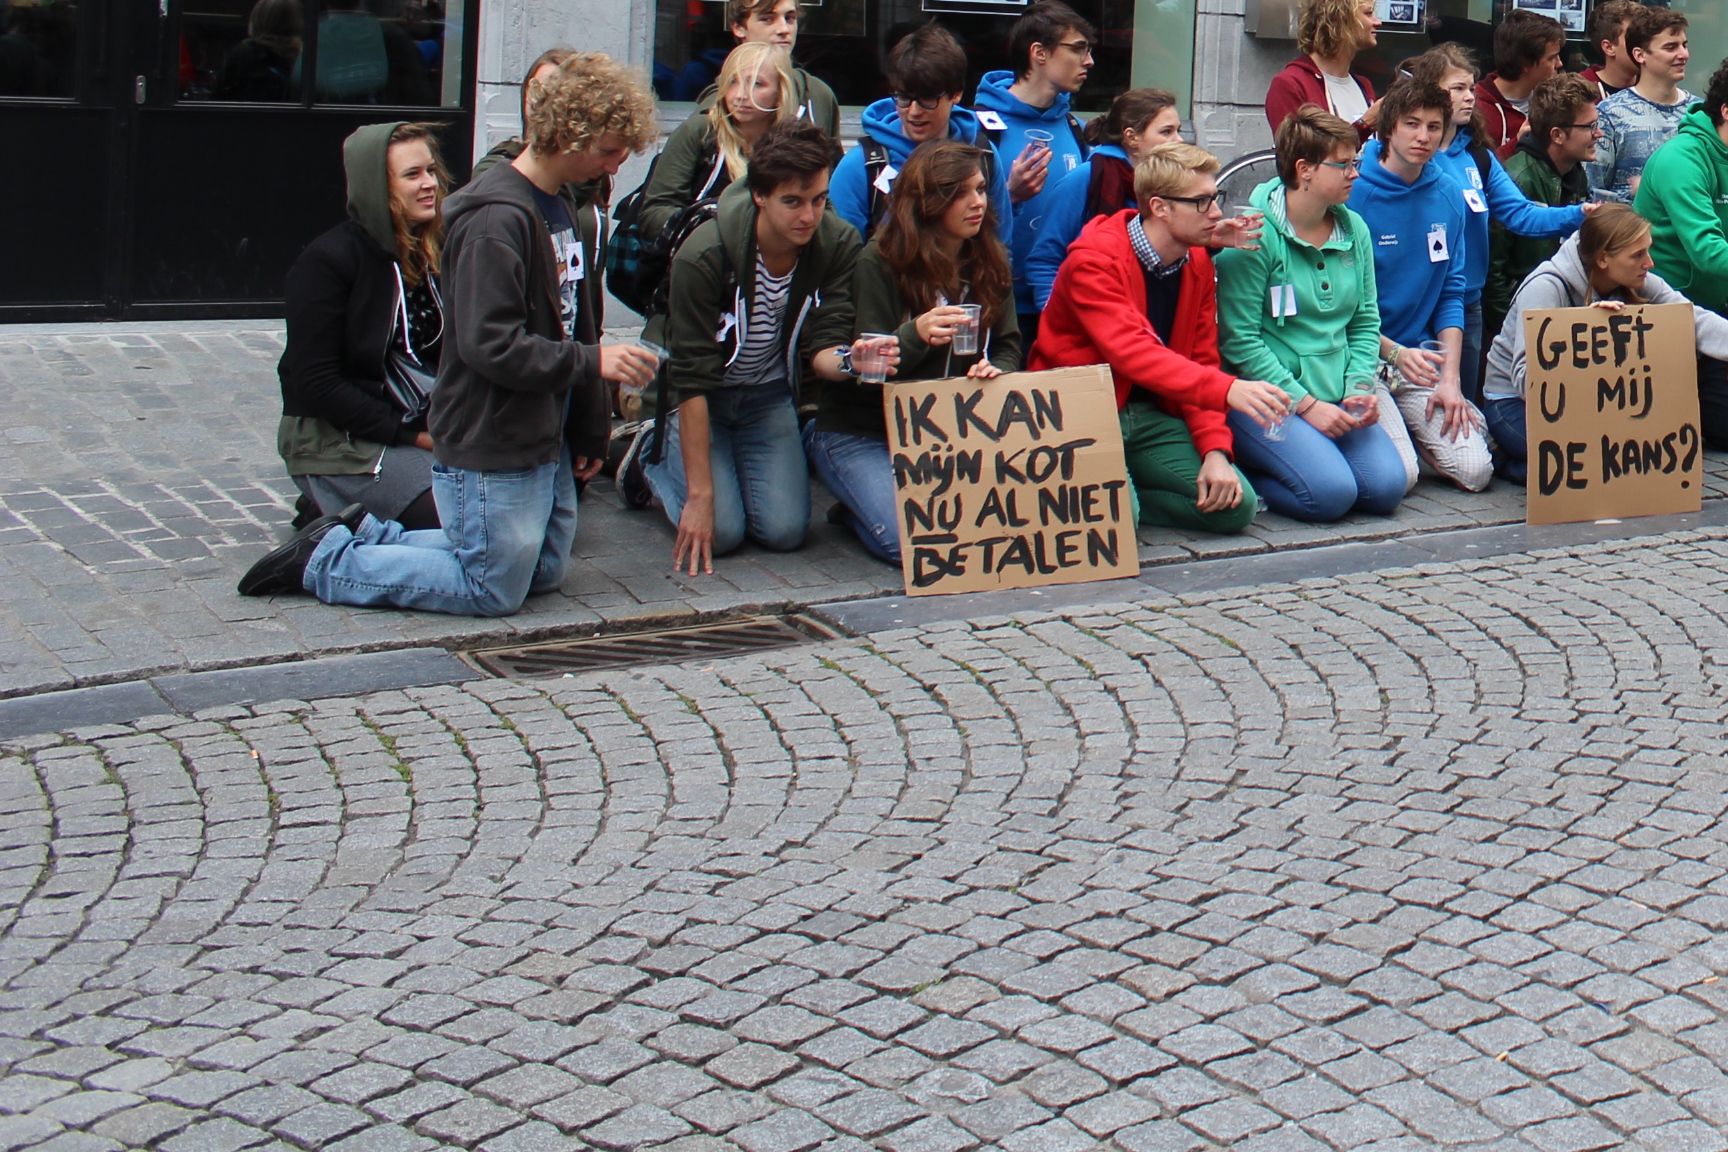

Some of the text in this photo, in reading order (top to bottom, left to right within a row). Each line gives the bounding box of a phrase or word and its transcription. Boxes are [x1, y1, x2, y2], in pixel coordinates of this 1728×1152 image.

[895, 388, 1063, 448] IK KAN
[1540, 381, 1566, 424] U
[995, 438, 1097, 485] KOT
[1538, 423, 1699, 497] DE KANS?
[904, 480, 1126, 538] NU AL NIET
[912, 528, 1119, 587] BETALEN
